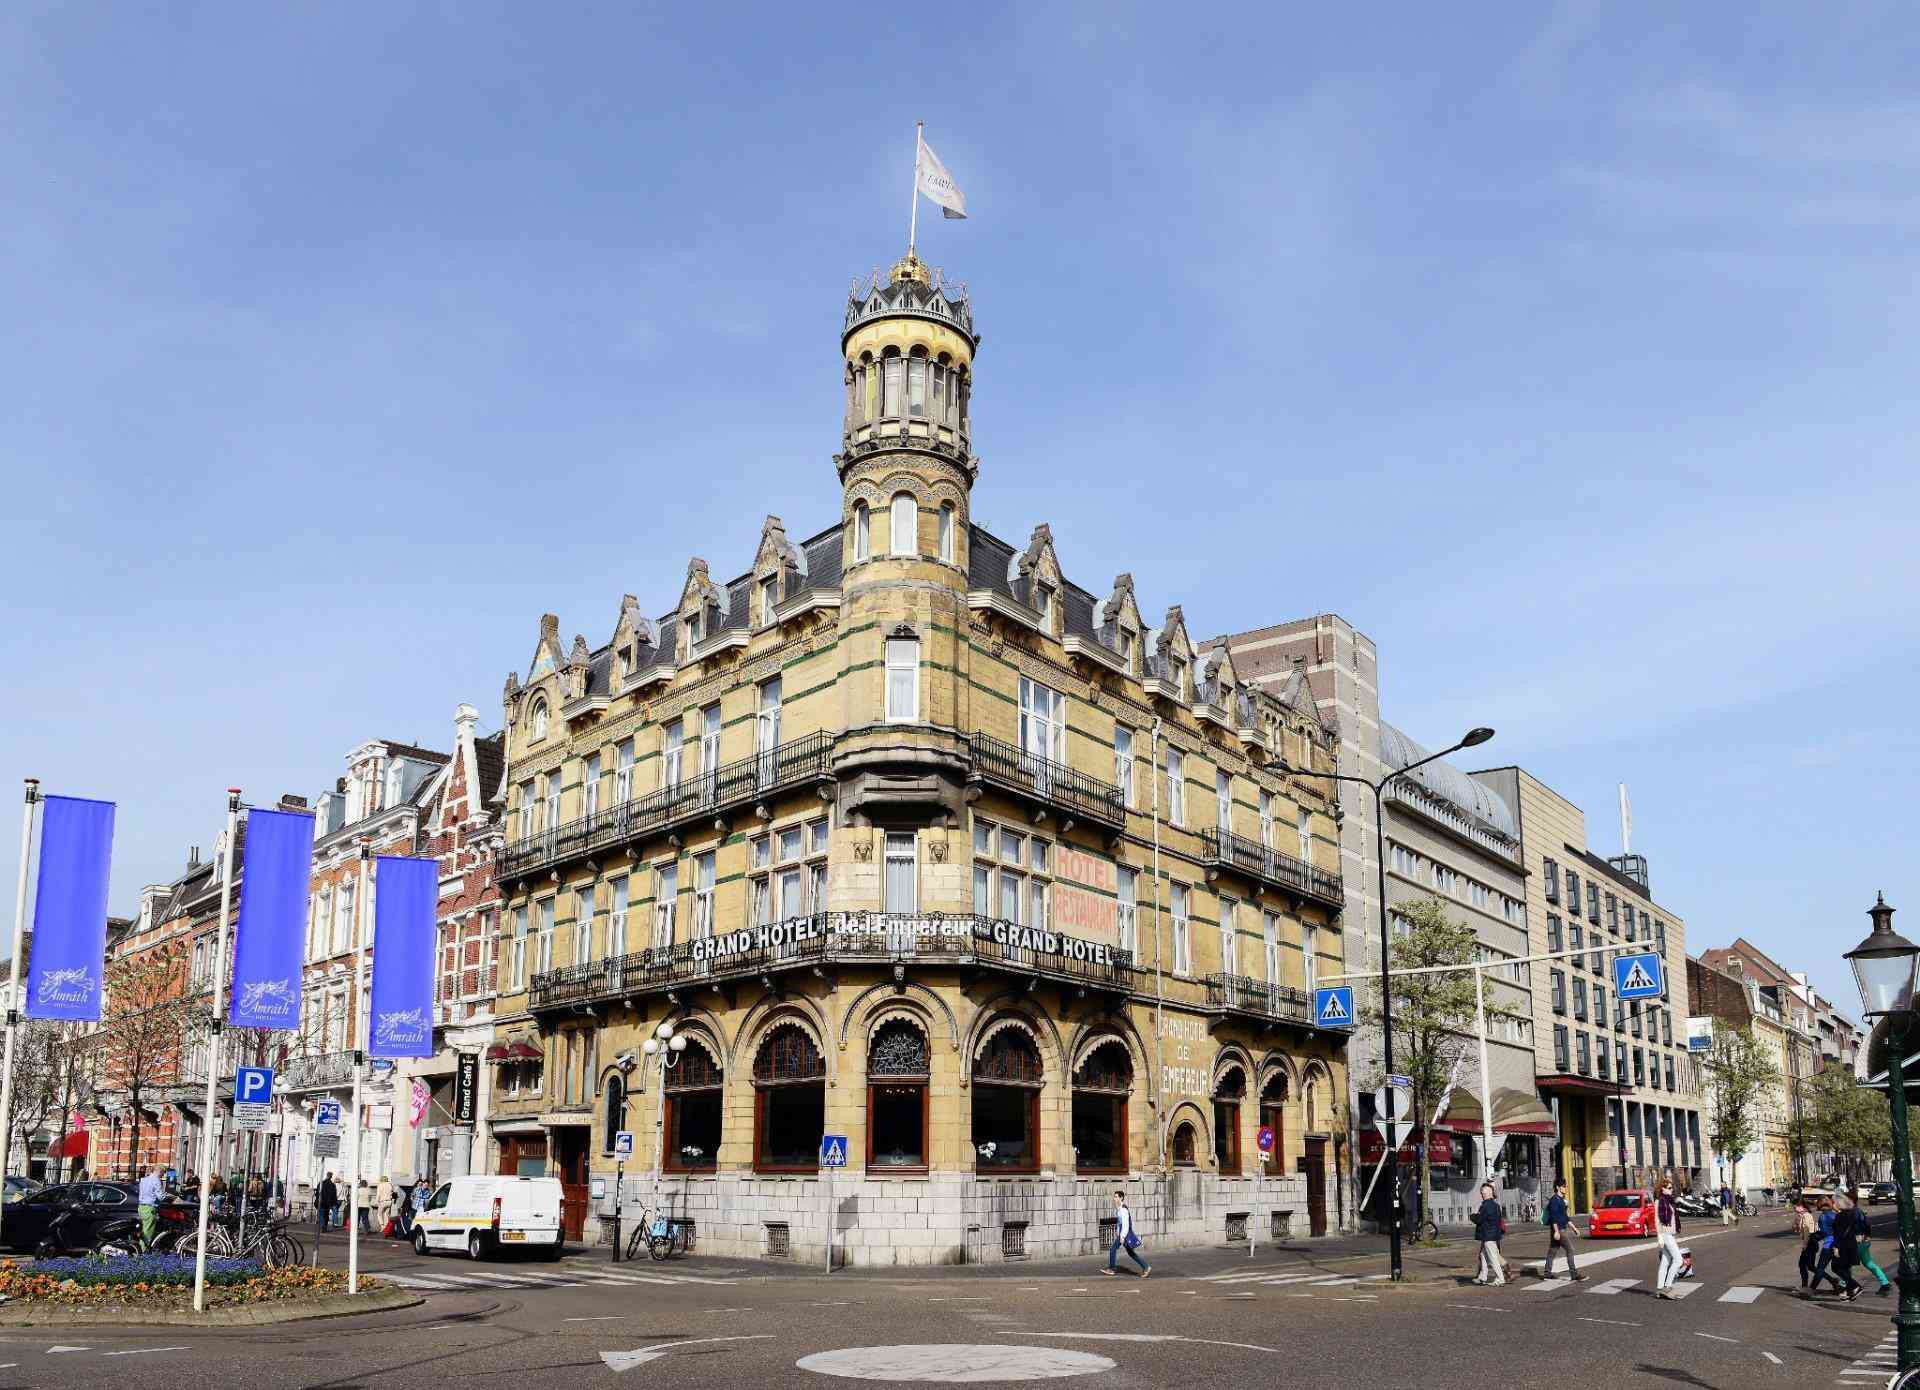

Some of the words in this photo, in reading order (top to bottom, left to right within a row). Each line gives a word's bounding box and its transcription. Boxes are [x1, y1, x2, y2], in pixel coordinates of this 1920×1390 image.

[1057, 847, 1116, 891] HOTEL
[693, 932, 751, 960] GRAND
[759, 916, 818, 948] HOTEL
[834, 913, 859, 934] de
[994, 919, 1056, 953] GRAND
[1062, 936, 1114, 966] HOTEL
[243, 1071, 265, 1099] P
[460, 1089, 471, 1119] Grand
